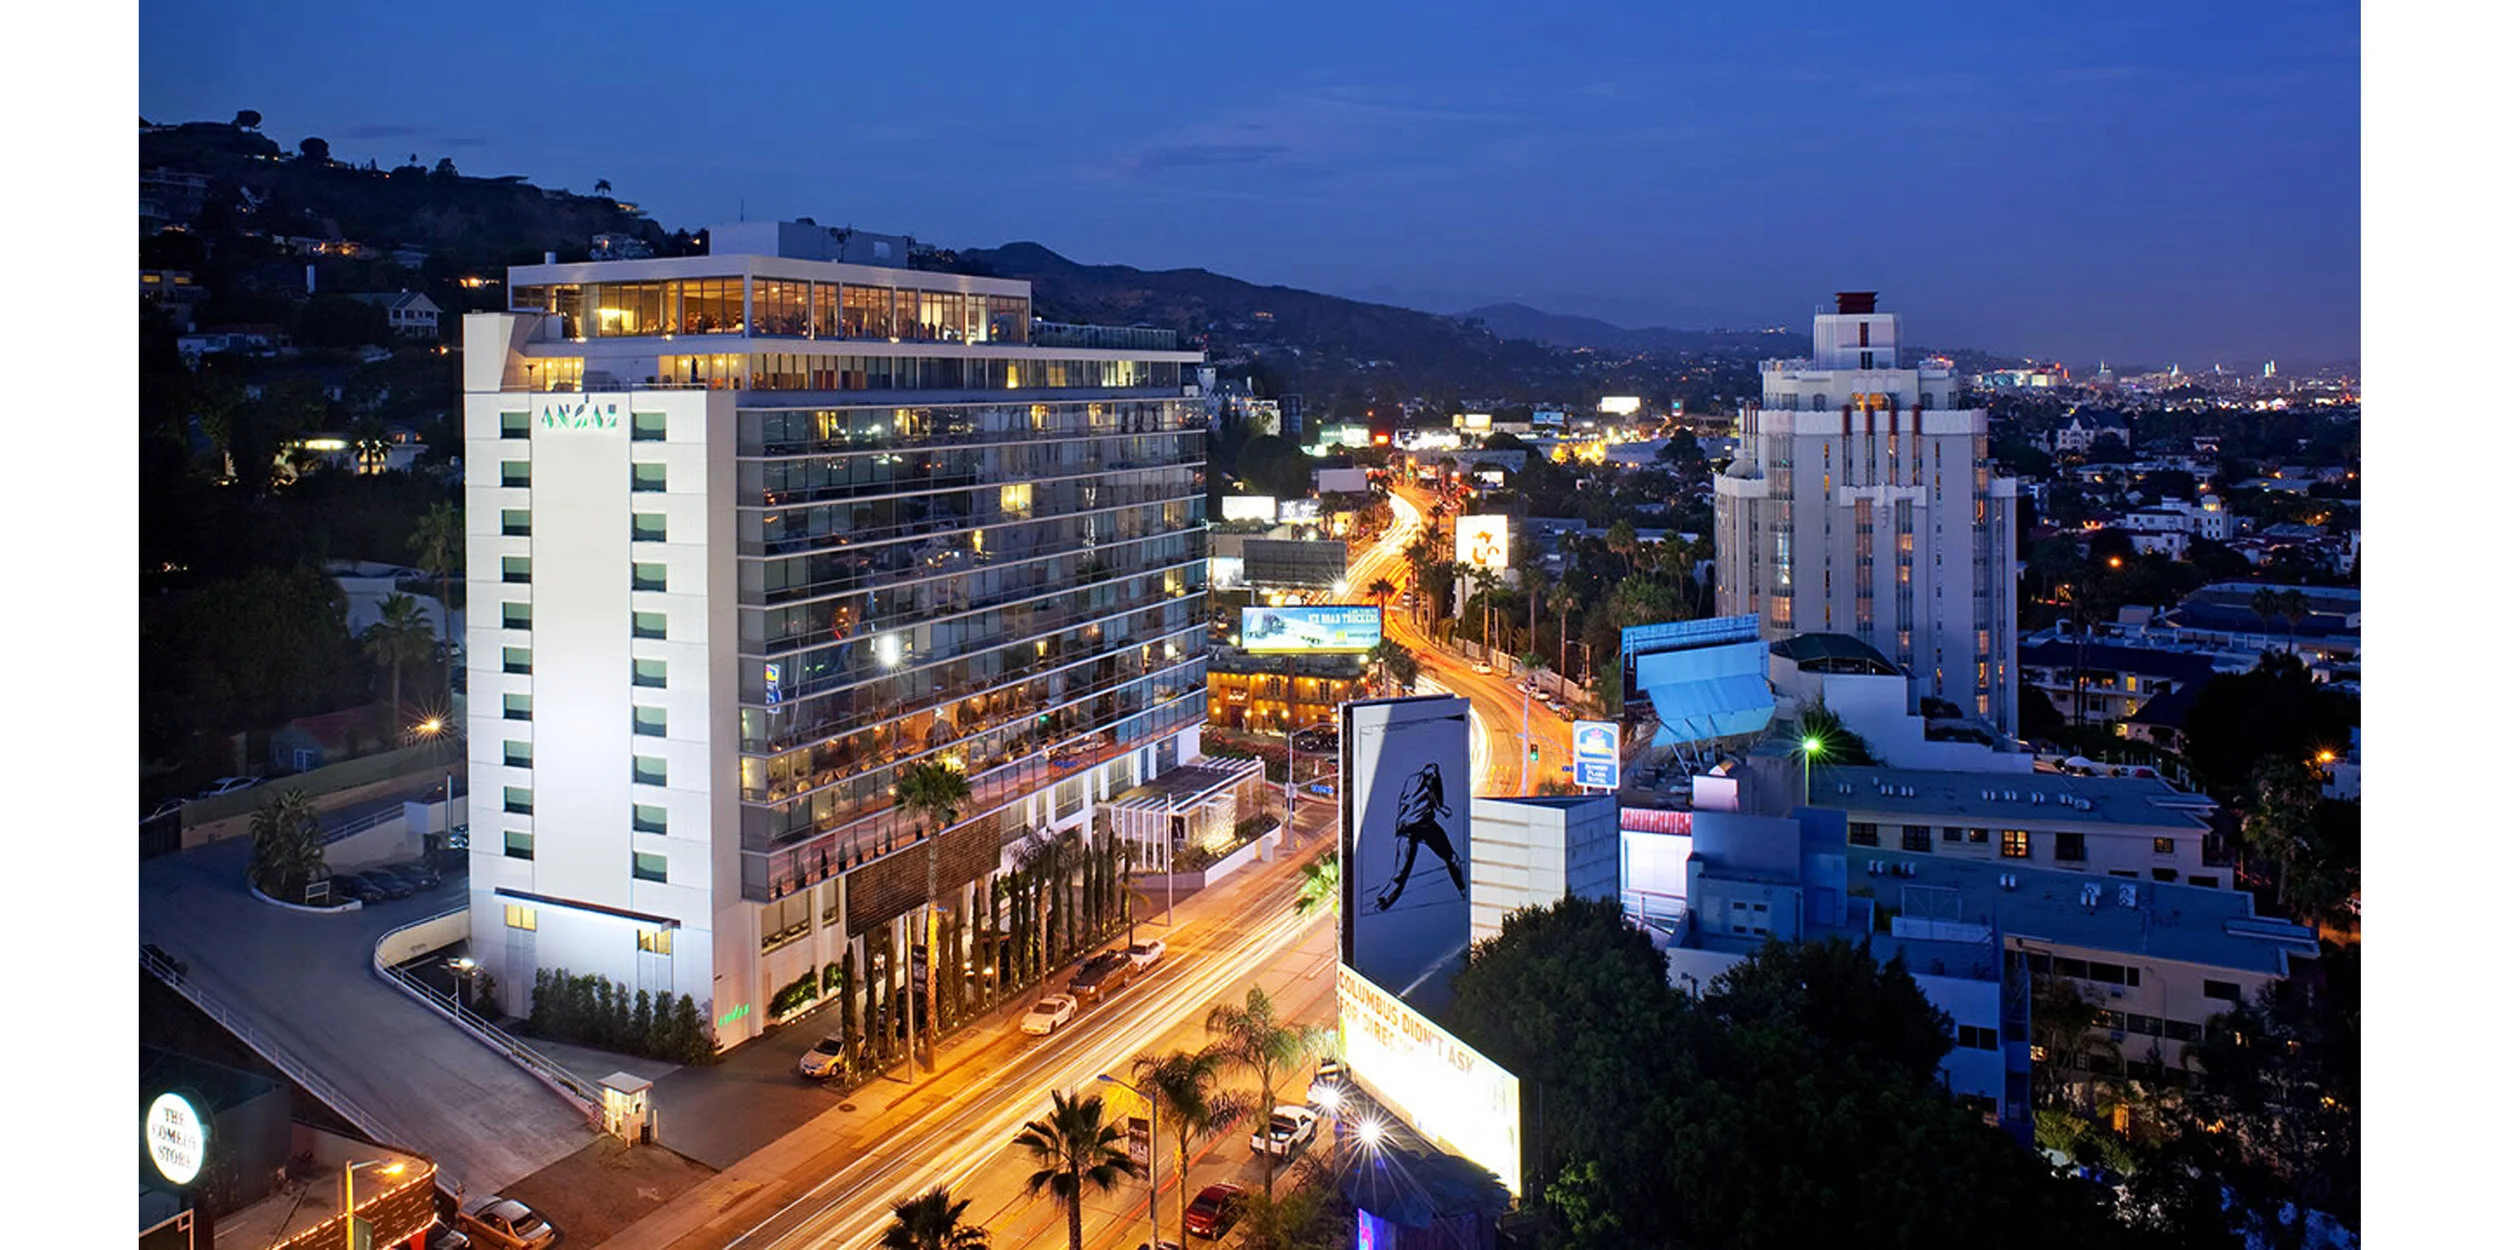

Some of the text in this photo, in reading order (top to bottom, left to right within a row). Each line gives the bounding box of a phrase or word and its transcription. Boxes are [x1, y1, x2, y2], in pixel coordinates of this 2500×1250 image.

[1339, 996, 1359, 1022] FOR
[1339, 971, 1399, 1027] COLUMBUS
[1448, 1046, 1475, 1075] ASK
[164, 1107, 184, 1126] THE
